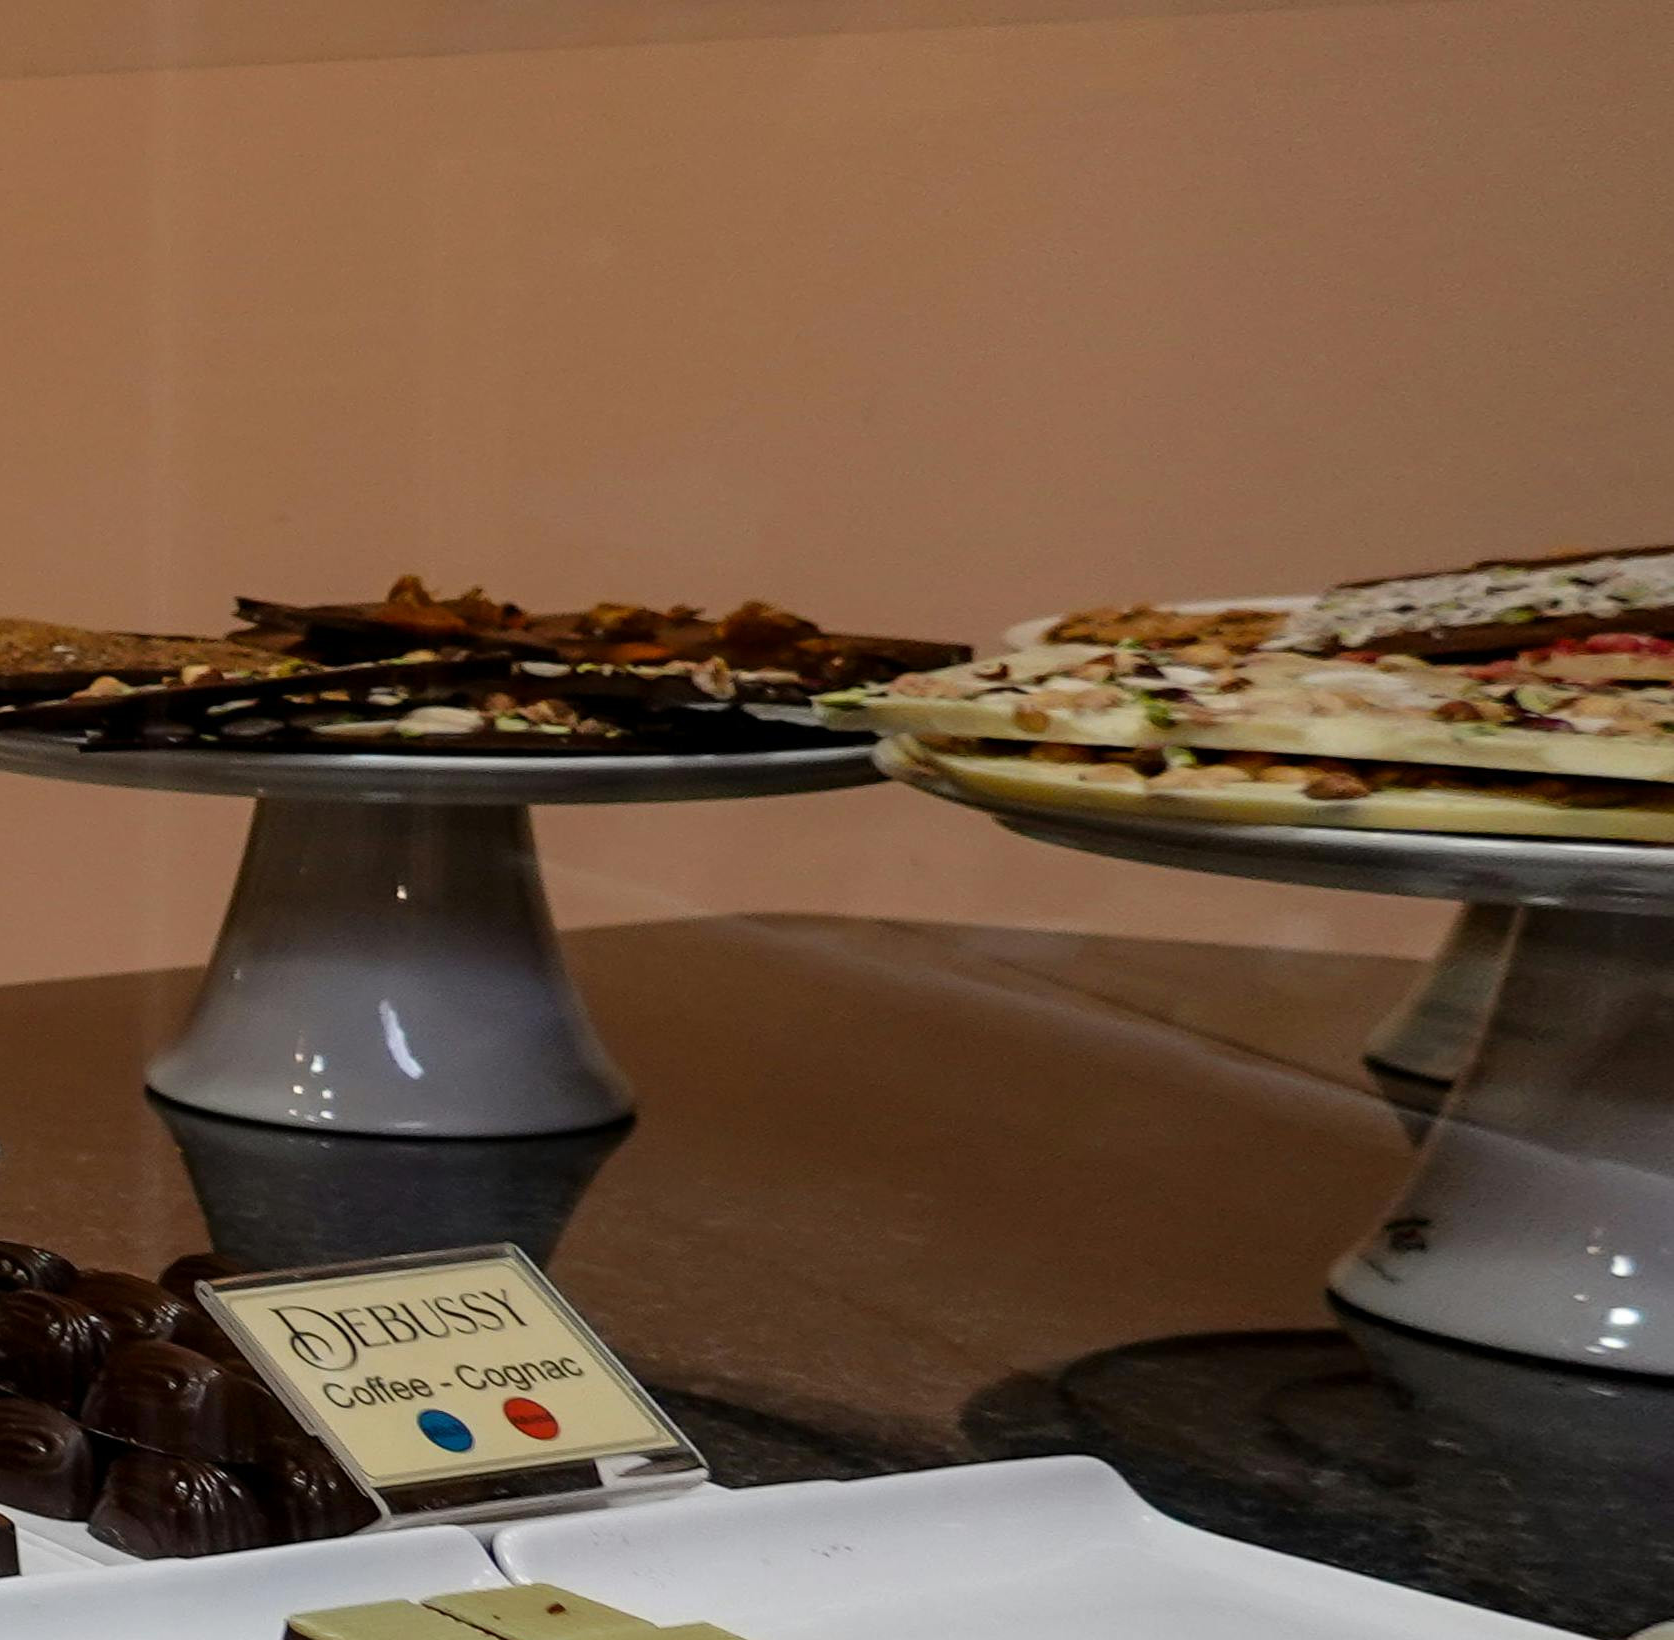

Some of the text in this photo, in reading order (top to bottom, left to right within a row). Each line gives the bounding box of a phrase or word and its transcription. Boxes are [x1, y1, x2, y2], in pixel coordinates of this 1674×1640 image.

[268, 1287, 530, 1372] DEBUSSY
[324, 1376, 434, 1410] Coffee
[455, 1354, 585, 1395] Cognac
